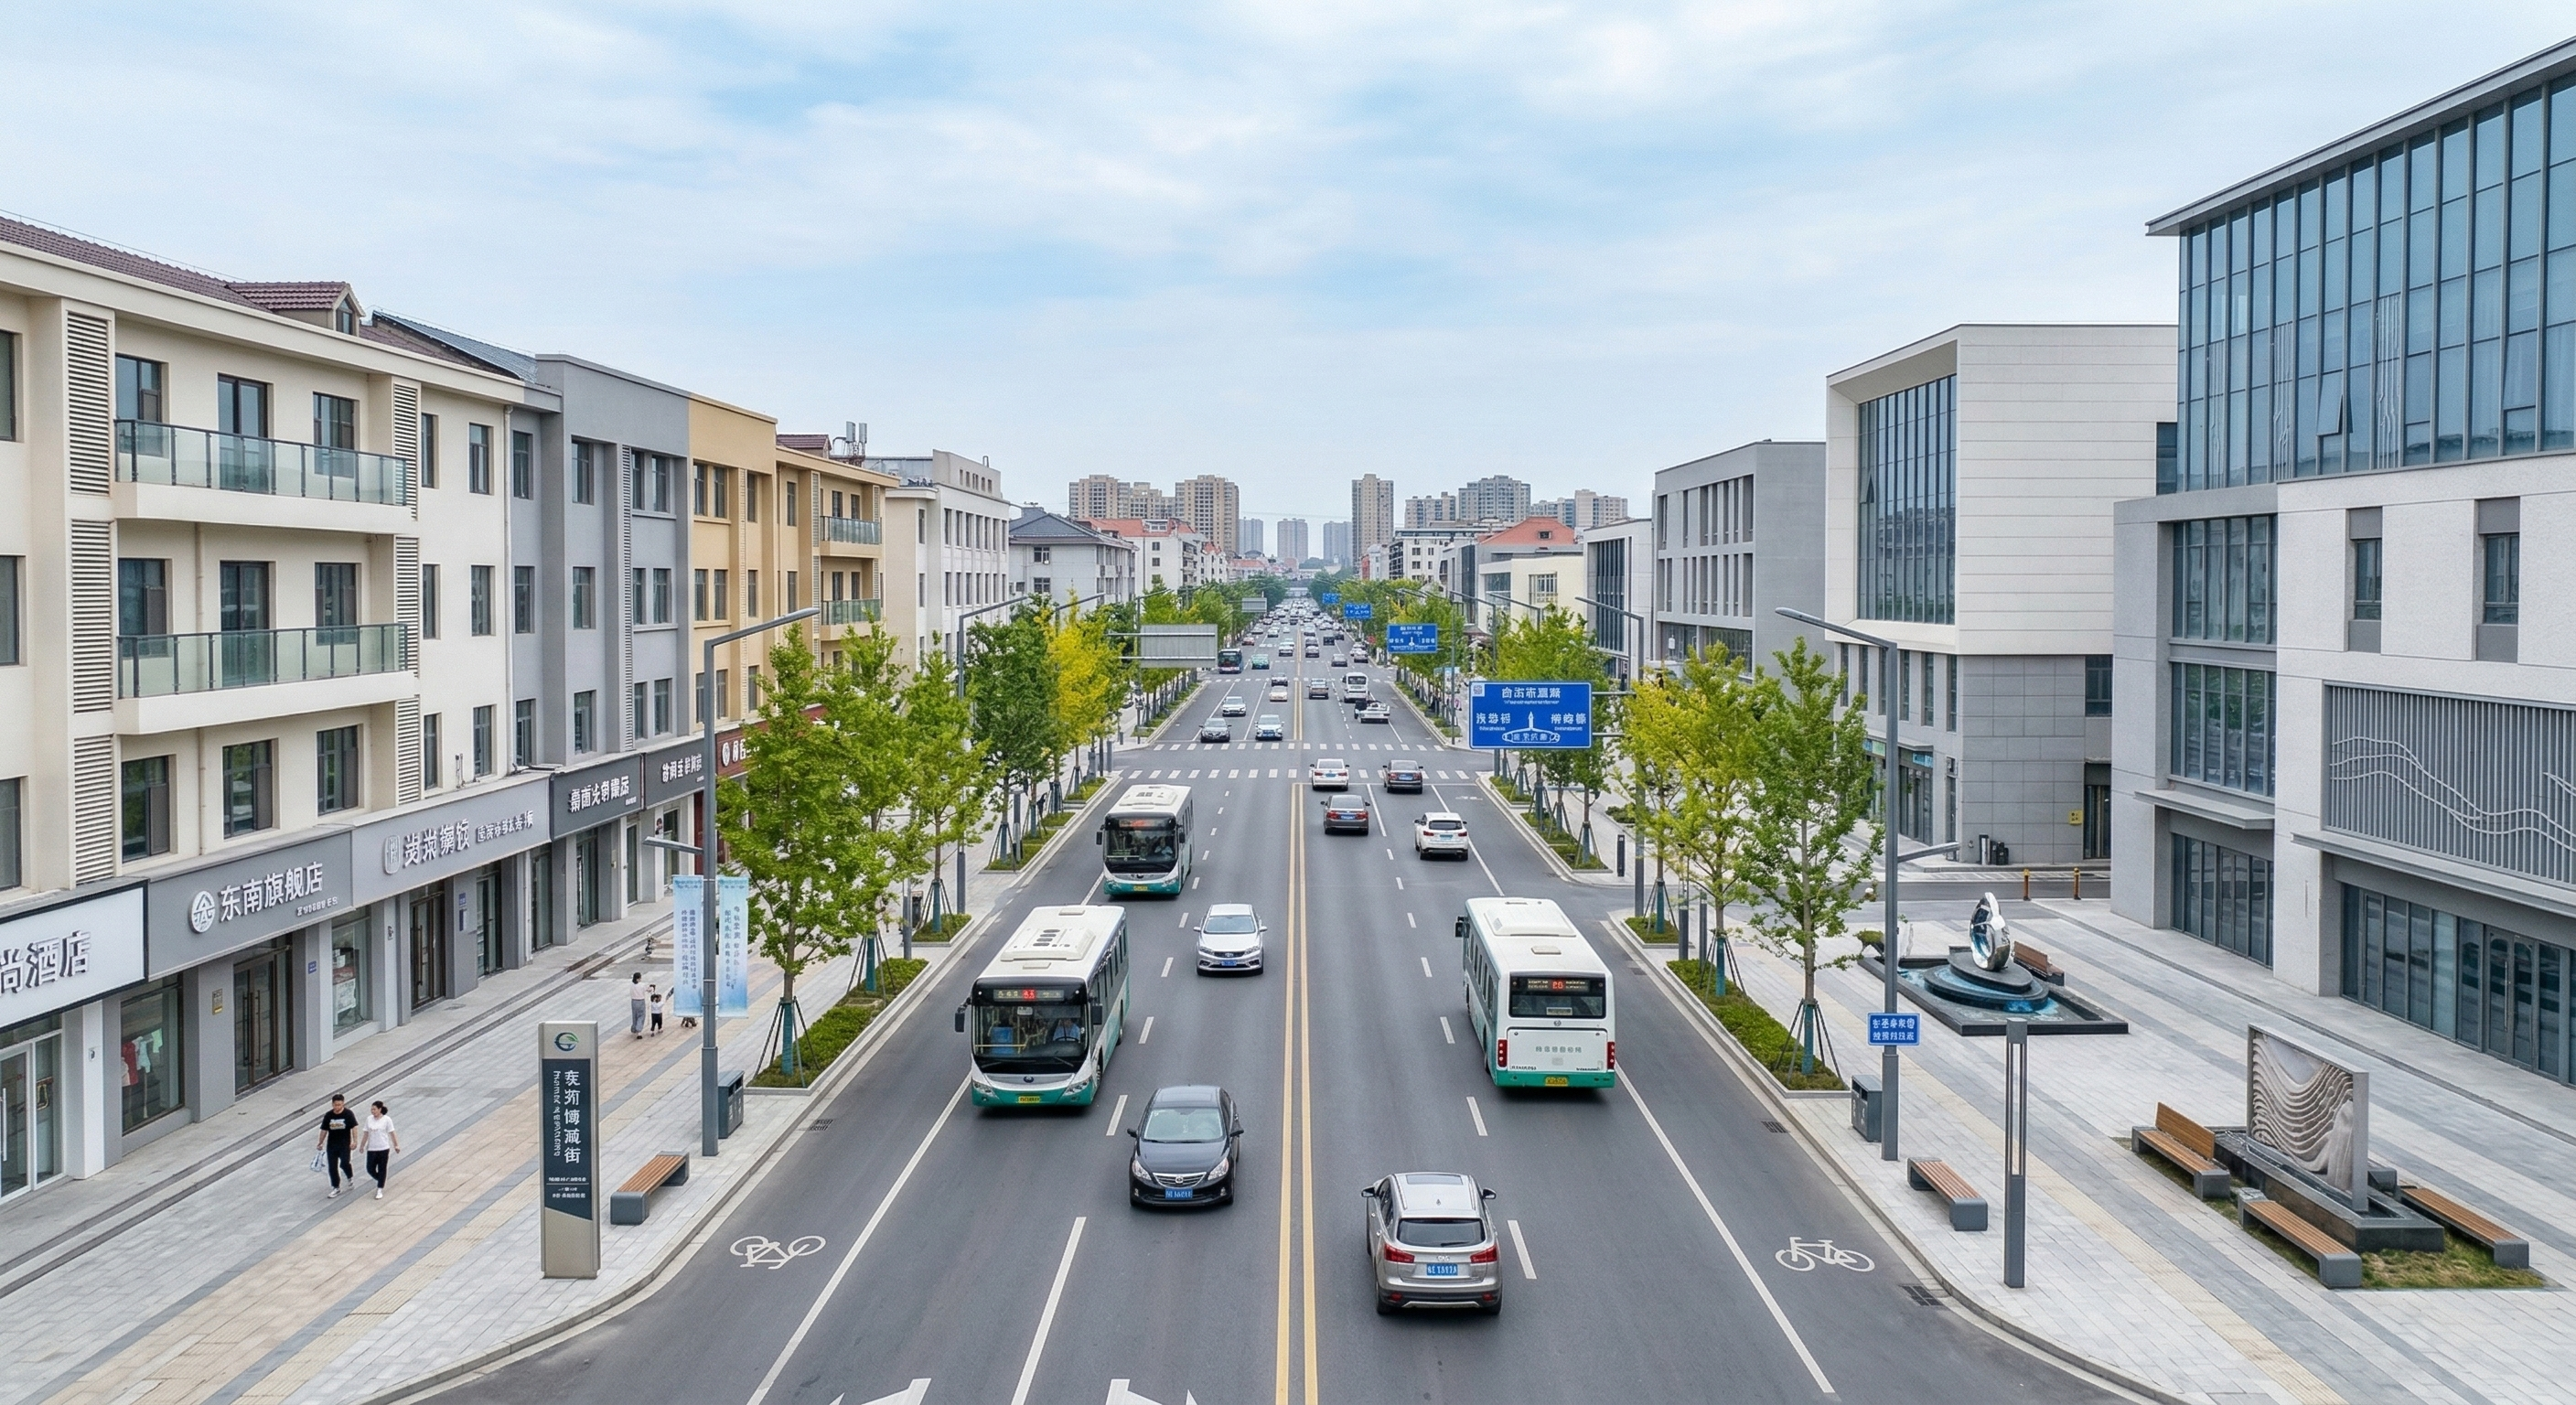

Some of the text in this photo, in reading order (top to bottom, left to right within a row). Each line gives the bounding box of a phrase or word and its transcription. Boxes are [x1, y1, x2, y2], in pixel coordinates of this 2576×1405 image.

[219, 862, 324, 923] 东南旗舰店
[0, 930, 91, 997] 尚酒店
